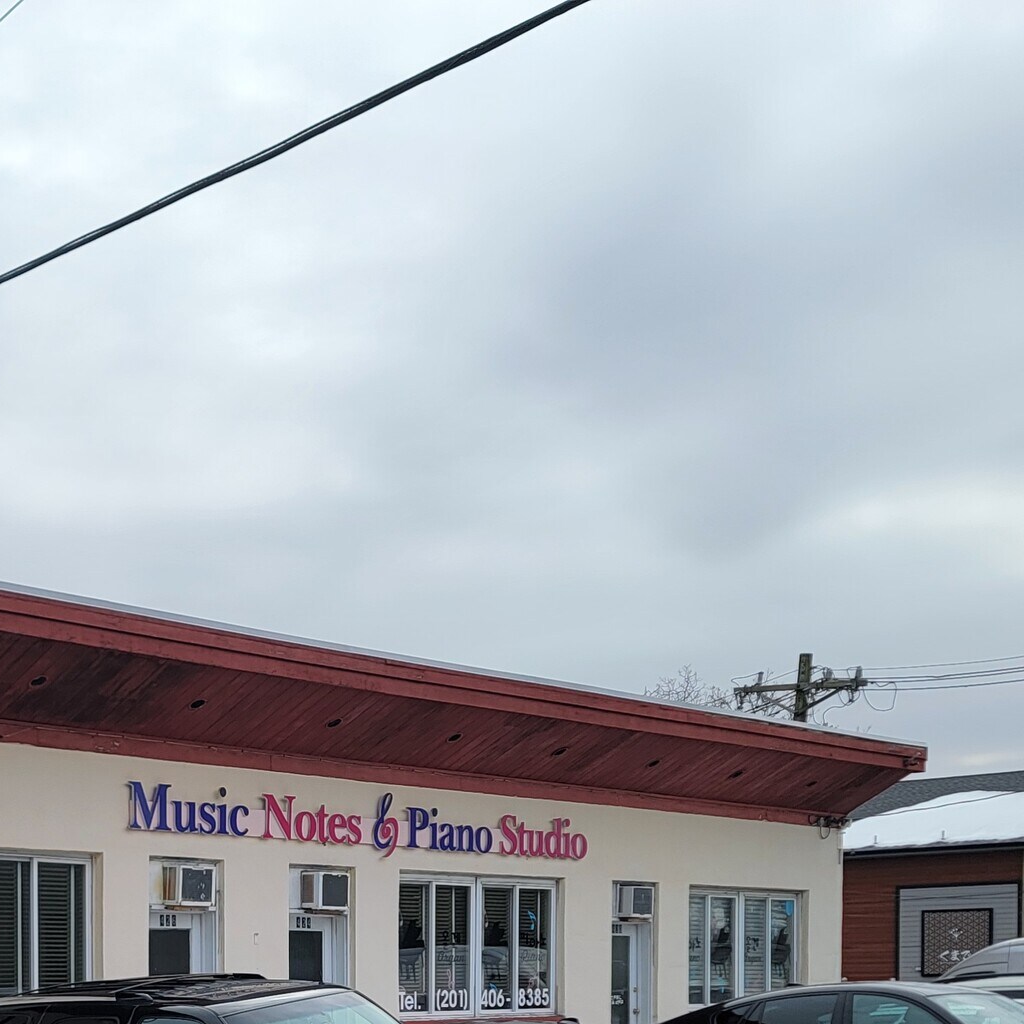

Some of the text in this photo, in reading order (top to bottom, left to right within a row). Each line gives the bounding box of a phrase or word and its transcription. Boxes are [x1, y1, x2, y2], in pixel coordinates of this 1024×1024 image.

[128, 781, 250, 836] Music
[262, 793, 362, 844] Notes
[406, 806, 493, 854] Piano
[499, 814, 589, 860] Studio
[399, 991, 422, 1010] Tel.
[436, 989, 468, 1010] (201)
[518, 988, 550, 1007] 8385
